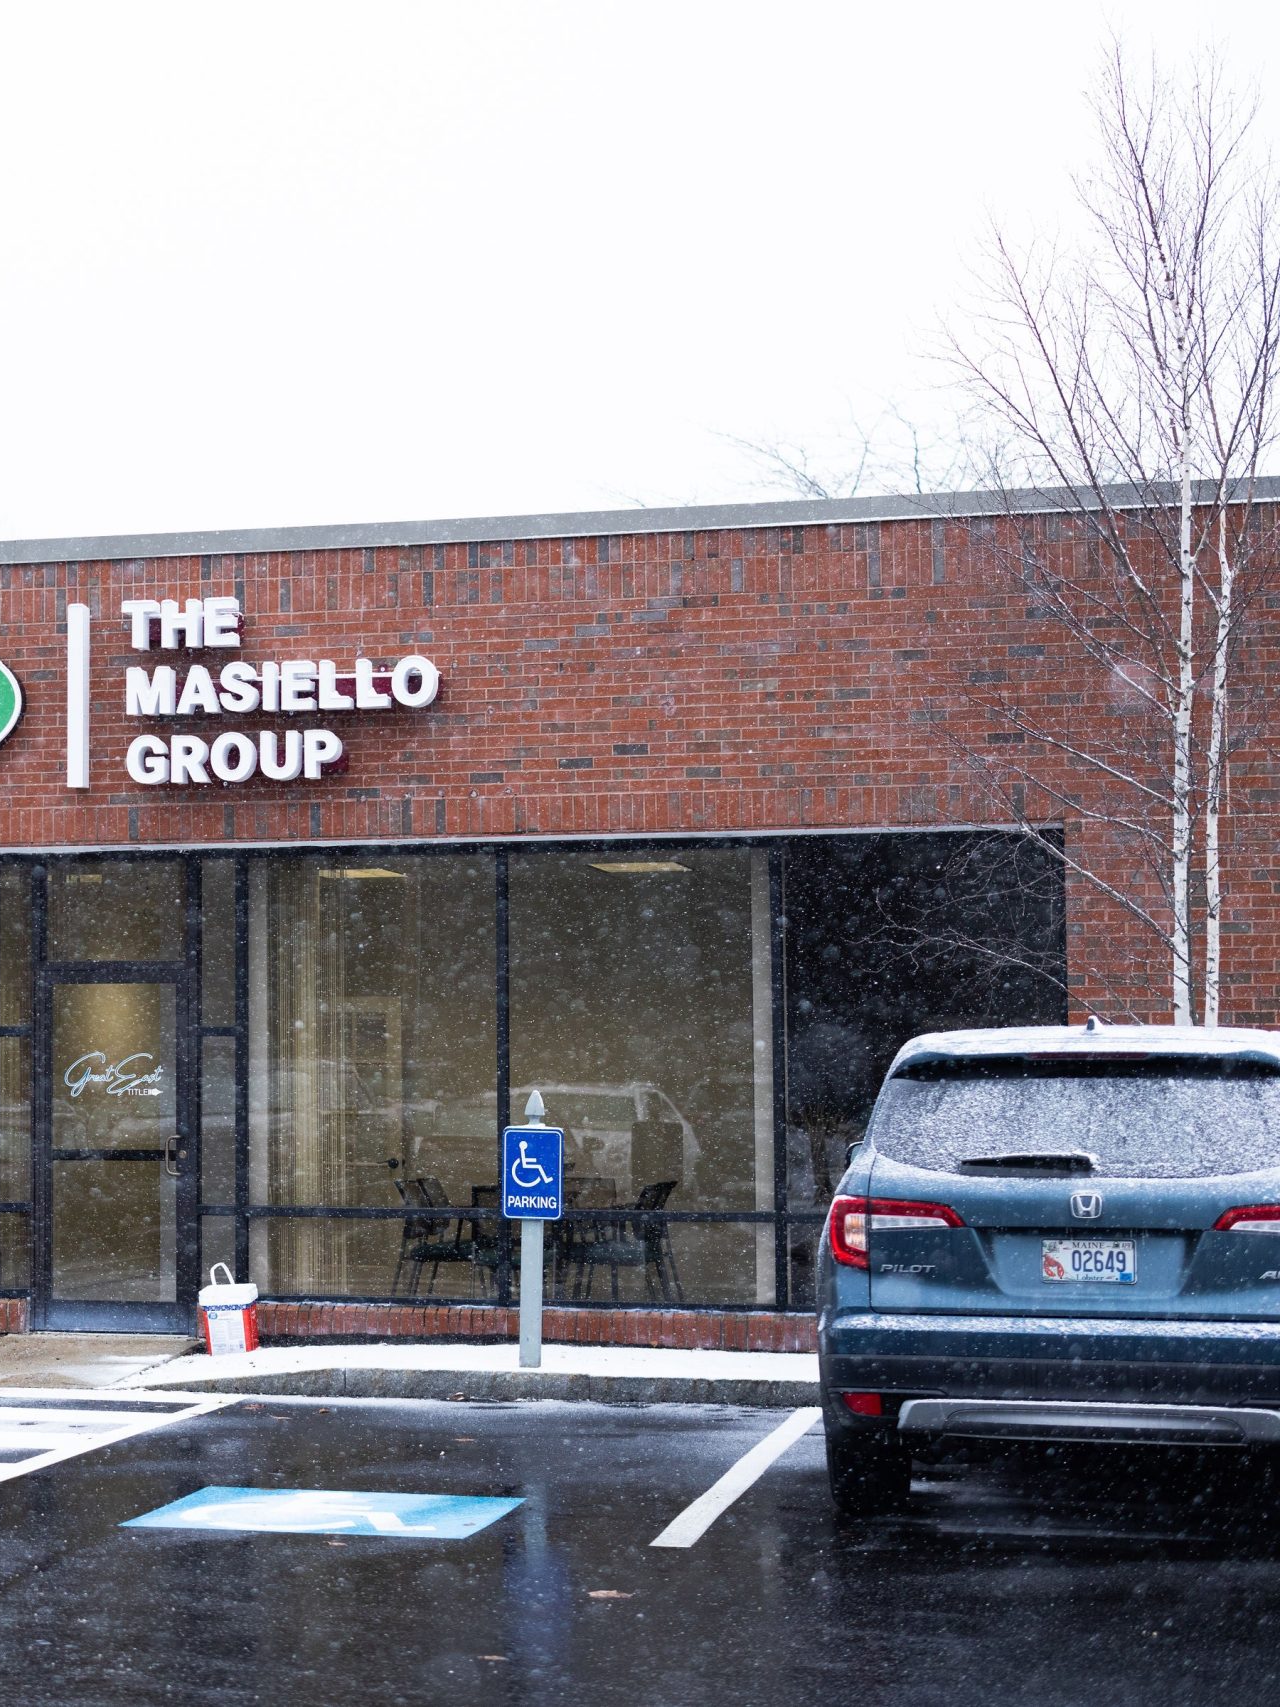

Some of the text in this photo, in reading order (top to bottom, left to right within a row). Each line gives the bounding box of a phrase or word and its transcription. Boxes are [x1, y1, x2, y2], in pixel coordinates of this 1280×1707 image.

[121, 597, 241, 650] THE
[125, 655, 439, 716] MASIELLO
[126, 729, 343, 785] GROUP
[64, 1051, 164, 1097] Great East
[127, 1088, 149, 1096] TITLE
[507, 1195, 557, 1209] PARKING
[1072, 1241, 1104, 1249] MAINE
[880, 1264, 936, 1273] PILOT
[1071, 1250, 1126, 1272] 02649
[1076, 1273, 1105, 1281] Lobster
